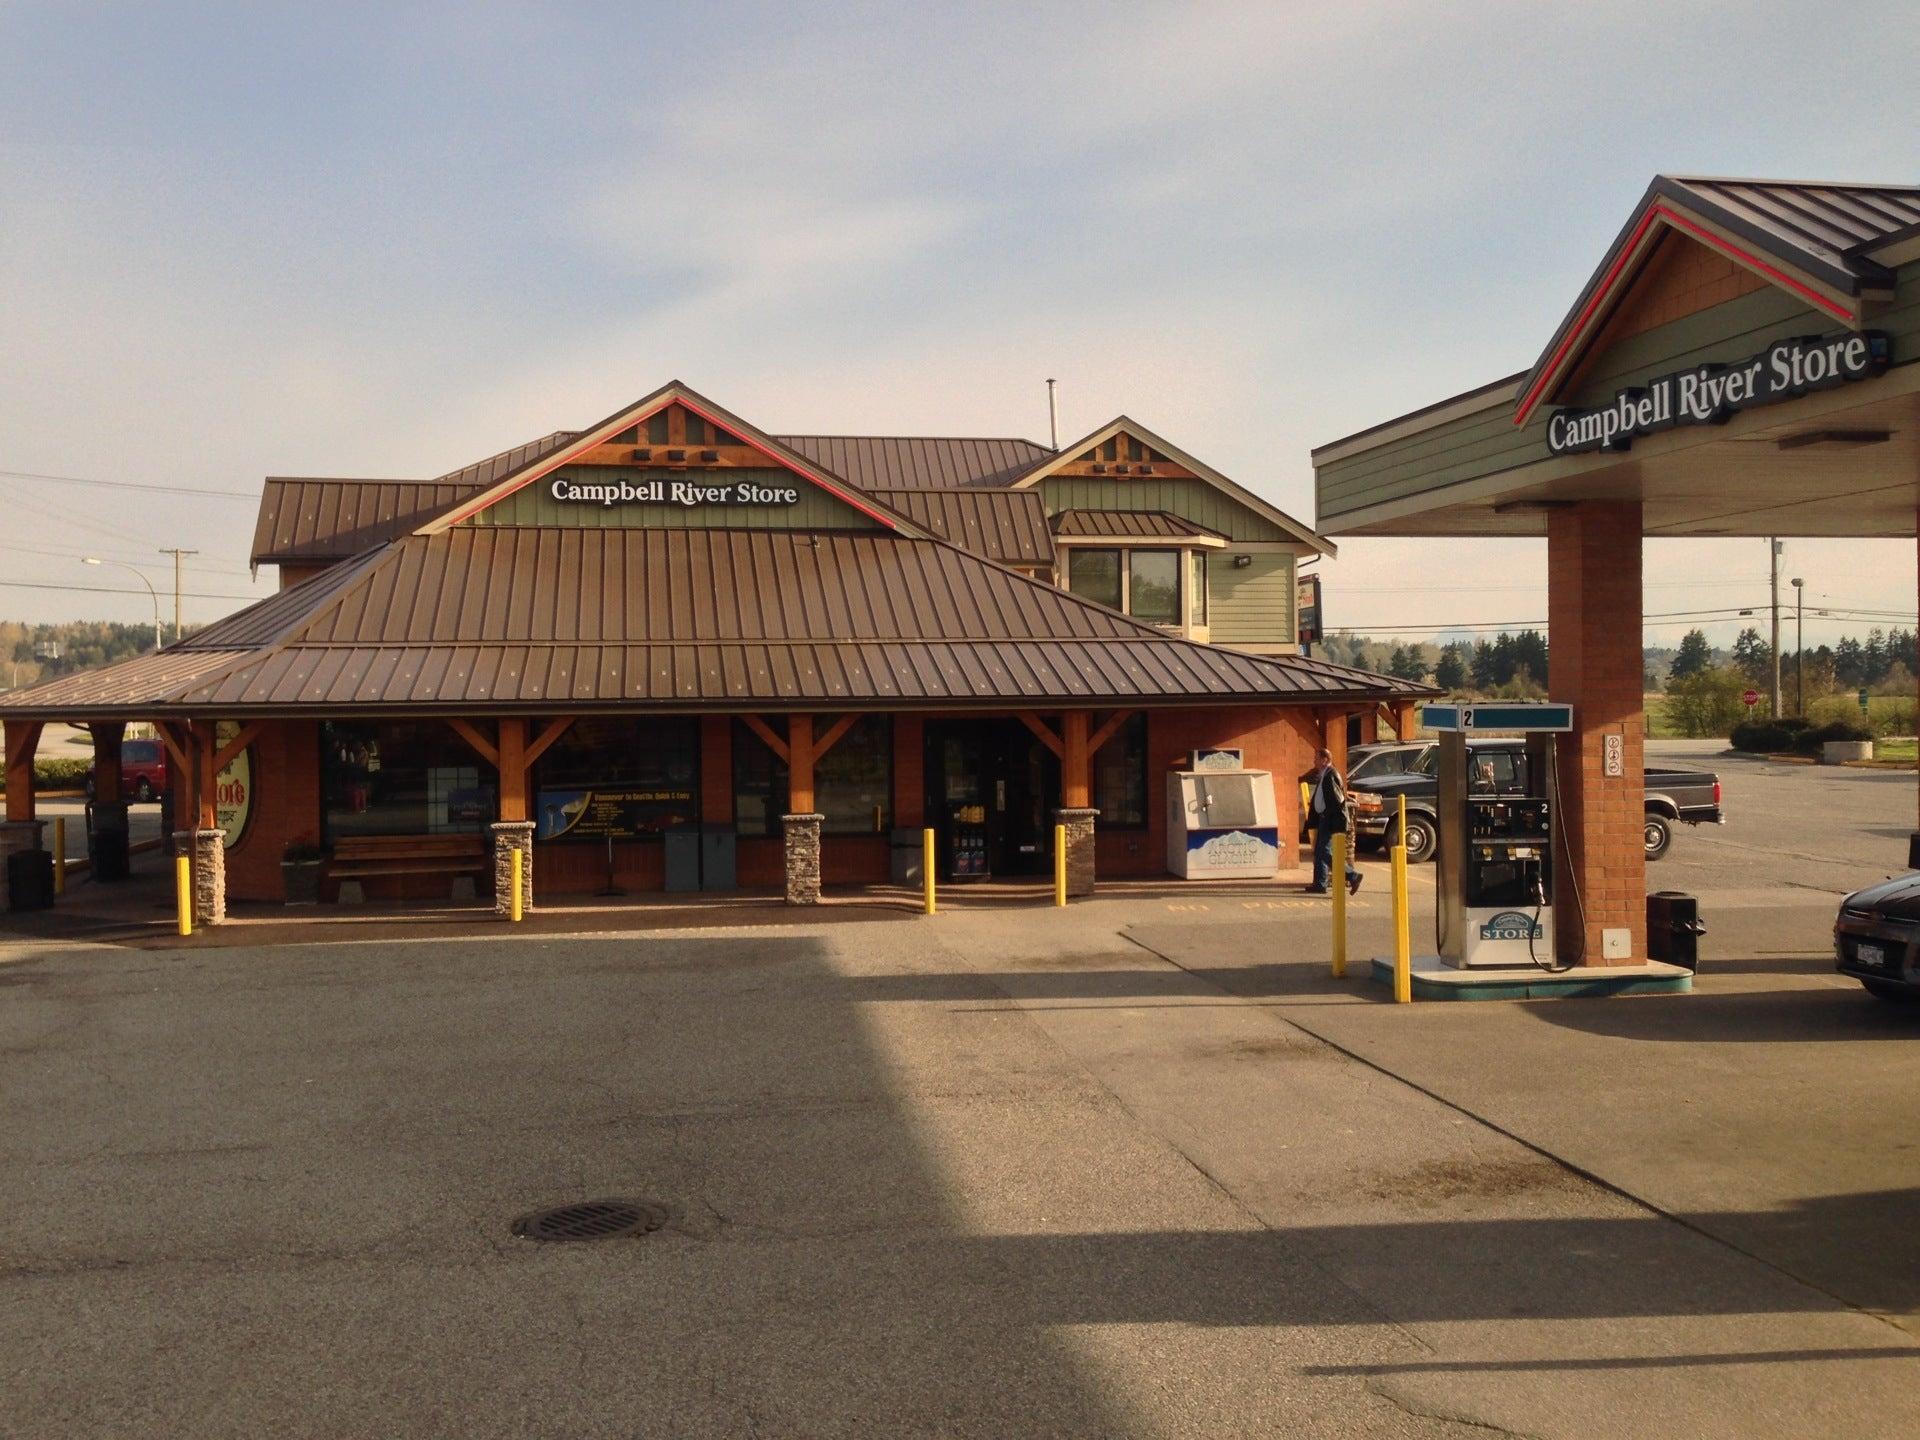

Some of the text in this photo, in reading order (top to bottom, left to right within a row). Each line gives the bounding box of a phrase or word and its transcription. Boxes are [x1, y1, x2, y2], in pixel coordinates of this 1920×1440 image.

[1549, 337, 1867, 451] Campbell River Store
[551, 480, 798, 506] Campbell River Store
[1463, 710, 1472, 727] 2
[1541, 803, 1549, 814] 2
